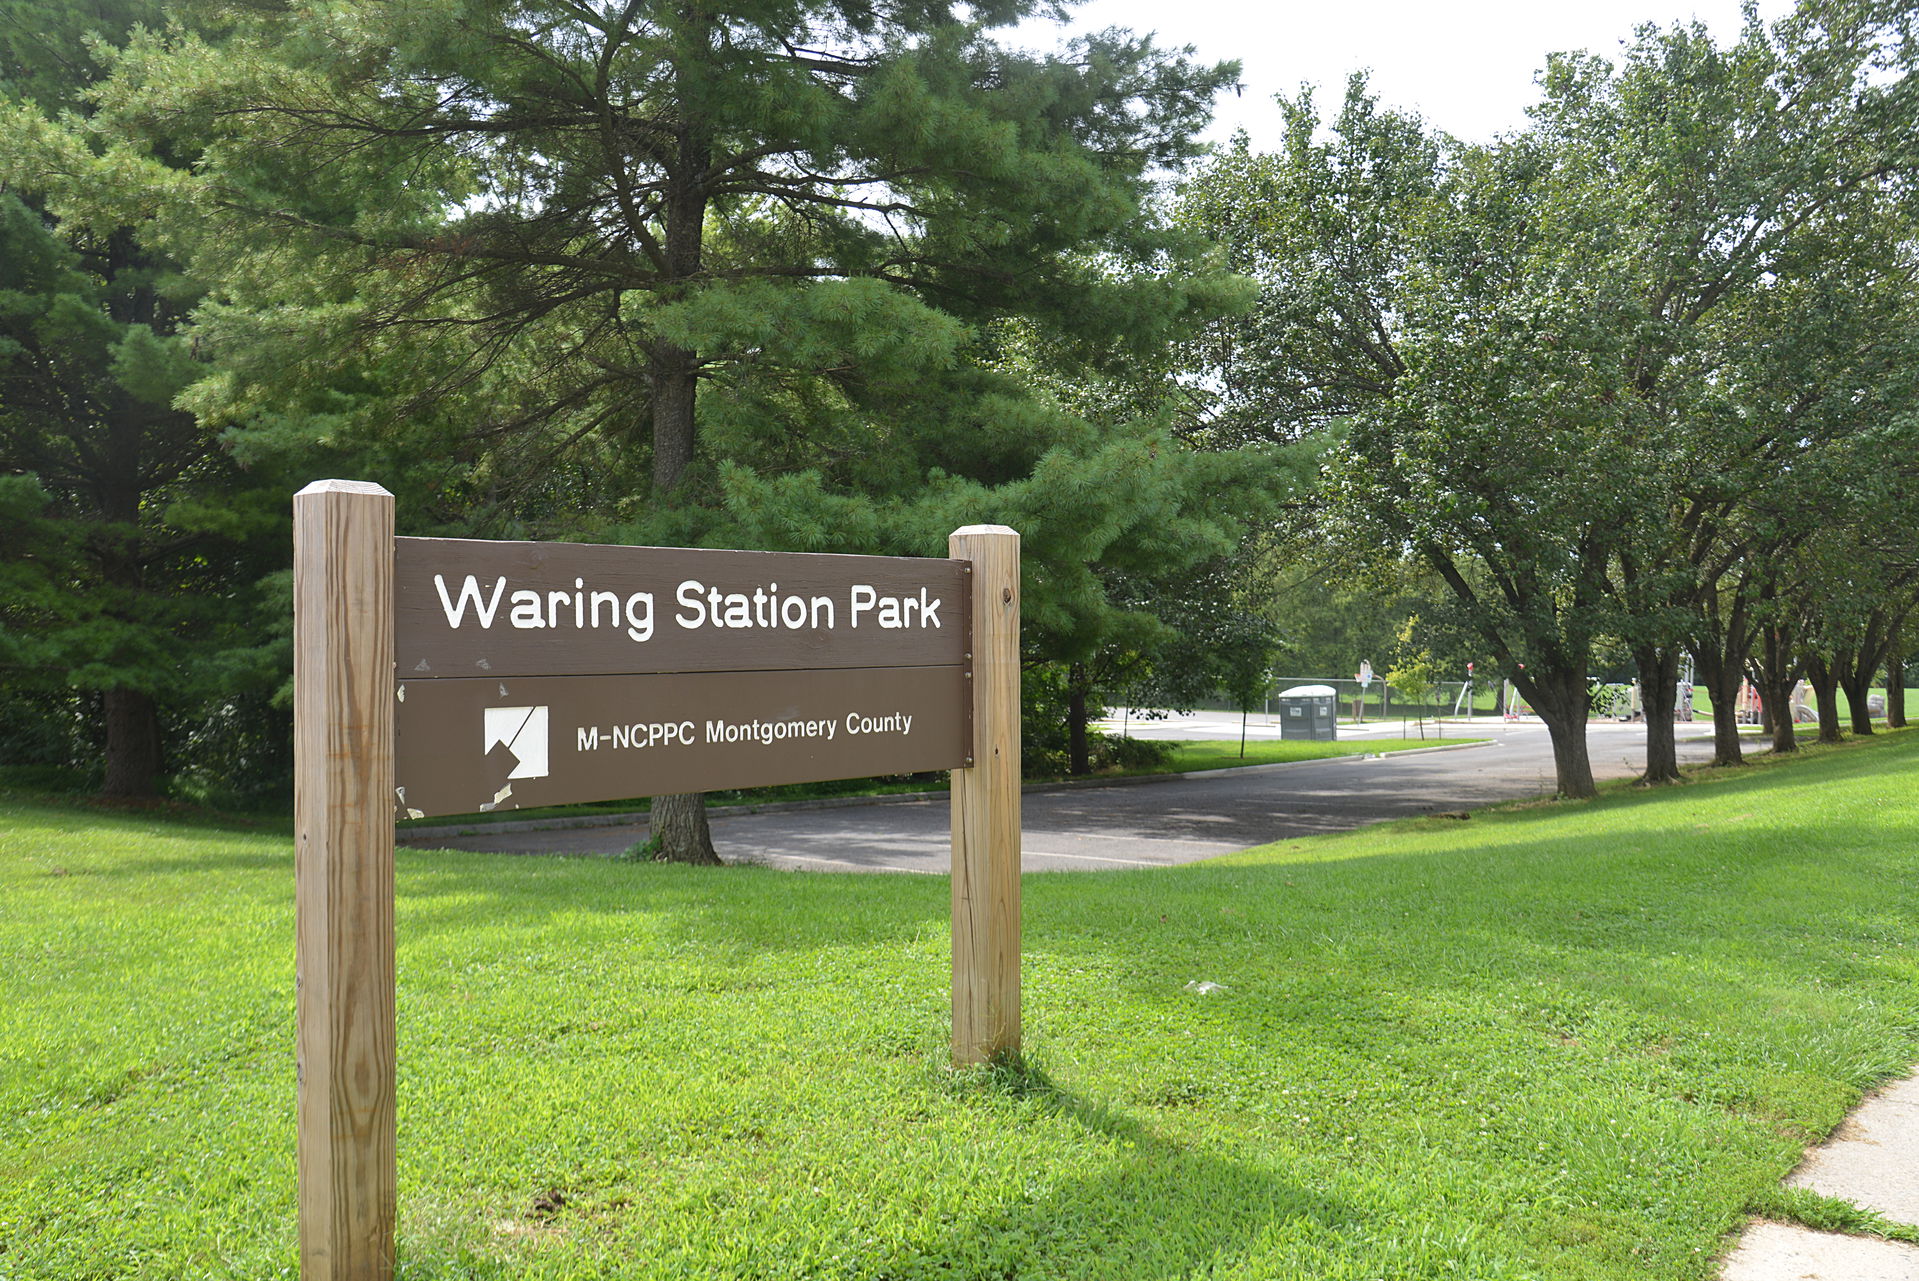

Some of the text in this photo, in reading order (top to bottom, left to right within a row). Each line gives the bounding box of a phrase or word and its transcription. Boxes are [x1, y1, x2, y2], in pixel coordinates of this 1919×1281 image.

[433, 574, 942, 643] Waring Station Park
[576, 711, 913, 752] M-NCPPC Montgomery County
